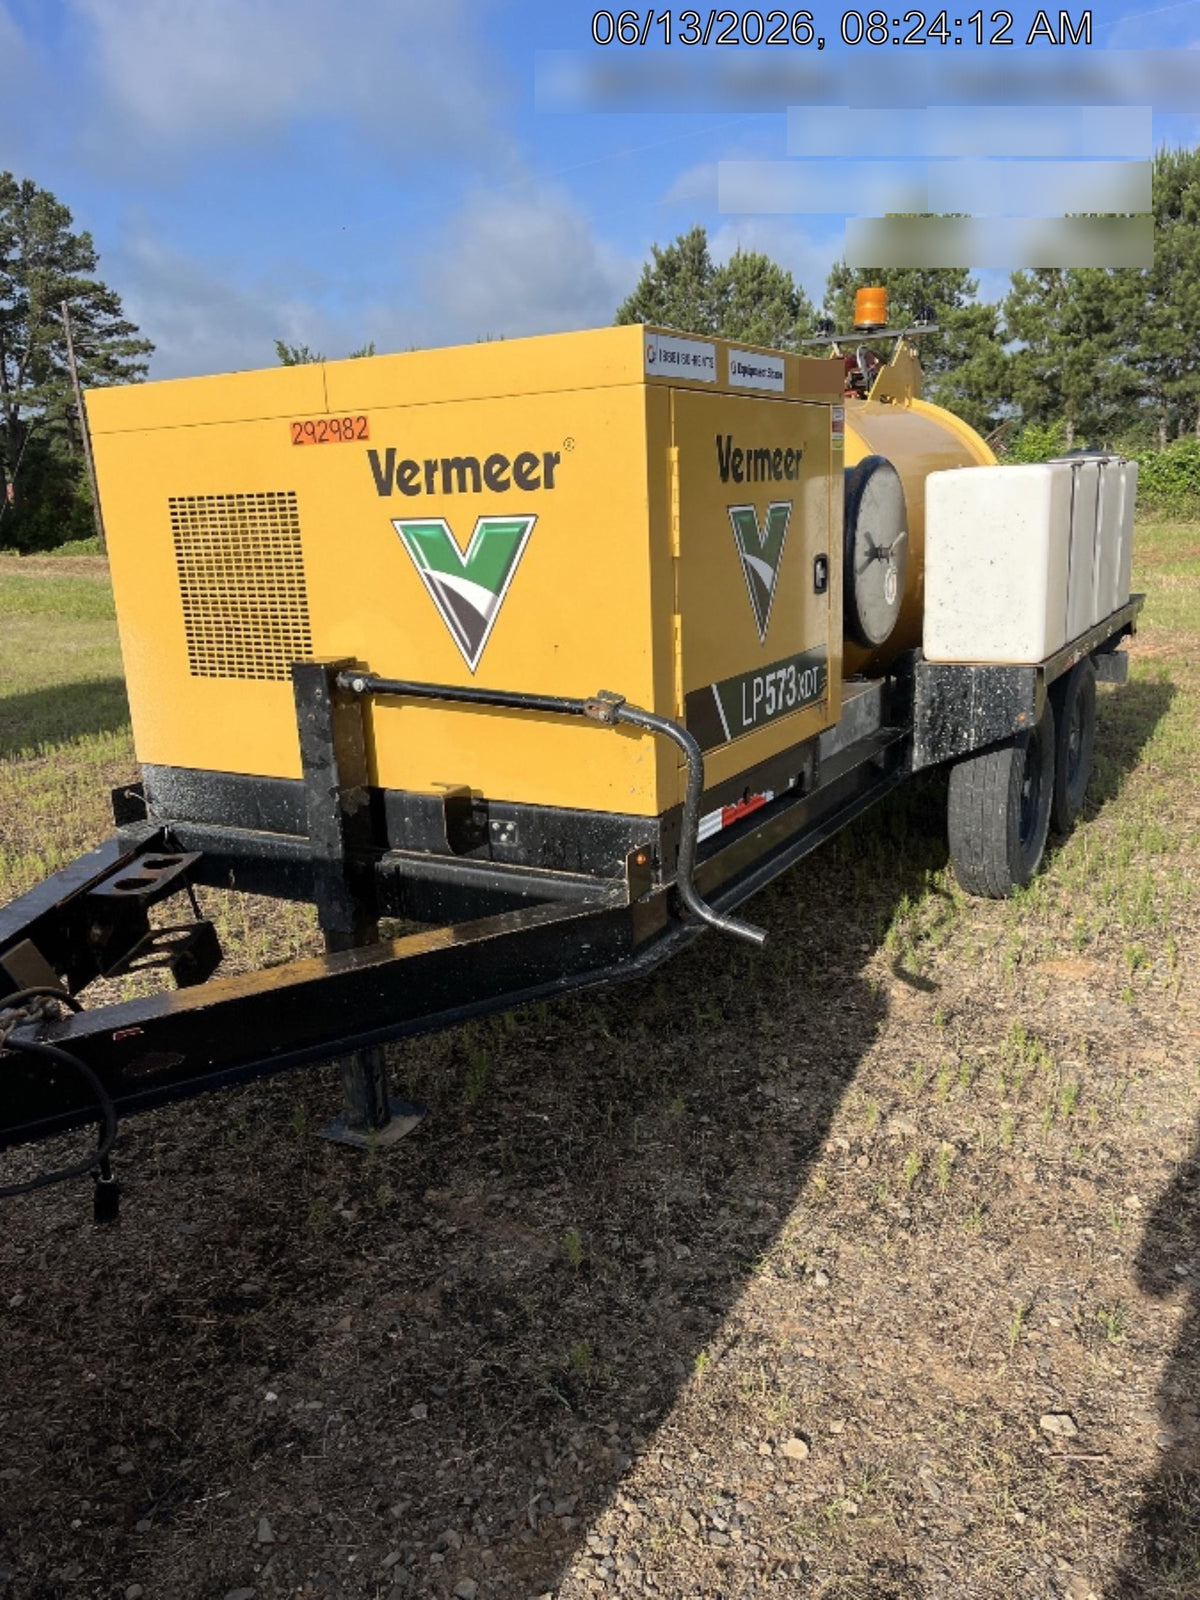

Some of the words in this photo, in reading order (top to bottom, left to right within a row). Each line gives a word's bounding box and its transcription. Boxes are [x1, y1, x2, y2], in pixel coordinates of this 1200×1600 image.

[291, 415, 369, 446] 292982
[366, 447, 561, 497] Vermeer
[716, 434, 803, 484] Vermeer
